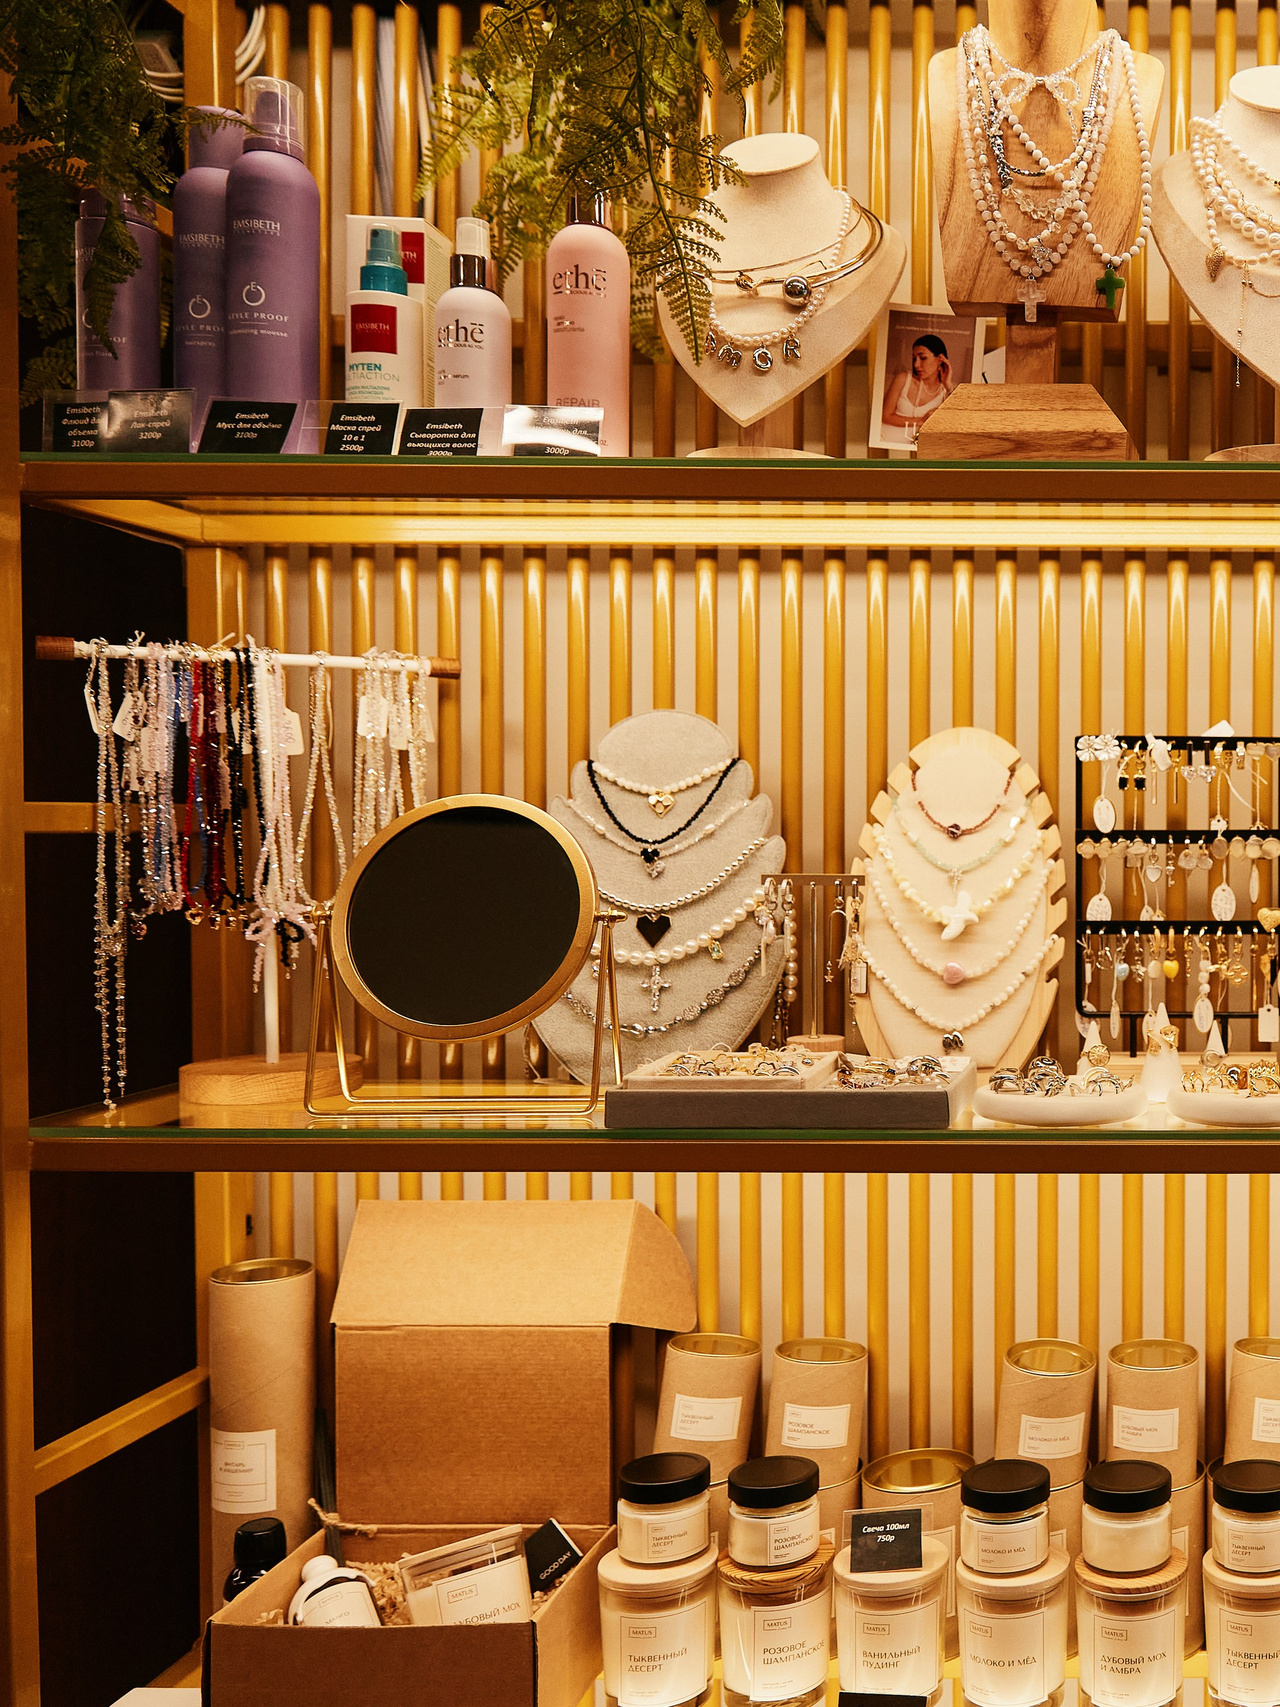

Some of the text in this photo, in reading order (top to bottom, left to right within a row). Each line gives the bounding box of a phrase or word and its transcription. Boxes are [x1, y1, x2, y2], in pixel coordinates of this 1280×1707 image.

[233, 219, 280, 231] EMSIBETH
[179, 233, 225, 245] EMSIBETH
[254, 312, 290, 323] PROOF
[66, 406, 101, 414] Emsibeth
[133, 409, 169, 418] Emsibeth
[340, 414, 376, 422] Emsibeth
[130, 419, 171, 429] Лак-спрей
[236, 421, 251, 429] для
[330, 424, 382, 433] Маска спрей
[138, 431, 162, 440] 3200р
[234, 431, 258, 439] 3100р
[409, 431, 476, 440] Сыворотка для
[71, 439, 95, 448] 3100р
[339, 444, 365, 452] 2500р
[407, 441, 476, 449] вьющихся волос
[545, 446, 570, 455] 3000р
[862, 1522, 910, 1533] Свеча 100мл
[652, 1531, 688, 1541] ТЫКВЕННЫЙ
[774, 1533, 802, 1544] РОЗОВОЕ
[876, 1534, 895, 1543] 750р
[652, 1540, 673, 1548] ДЕСЕРТ
[773, 1534, 815, 1551] ШАМПАНСКОЕ
[1232, 1543, 1266, 1551] ТЫКВЕННЫЙ
[539, 1550, 573, 1580] GOOD DAY
[451, 1588, 475, 1599] MATUS
[453, 1601, 522, 1624] УБОВЫЙ МОХ
[766, 1620, 788, 1628] MATUS
[762, 1639, 825, 1665] ШАМПАНСКОЕ
[763, 1640, 807, 1655] РОЗОВОЕ
[862, 1646, 921, 1659] ВАНИЛЬНЫЙ
[628, 1647, 688, 1663] ТЫКВЕННЫЙ
[970, 1653, 1037, 1667] МОЛОКО И МЁД
[1100, 1650, 1167, 1665] ДУБОВЫЙ МОХ
[627, 1663, 664, 1673] ДЕСЕРТ
[862, 1660, 900, 1670] ПУДИНГ
[1226, 1658, 1259, 1670] ДЕСЕРТ
[1109, 1666, 1141, 1675] АМБРА
